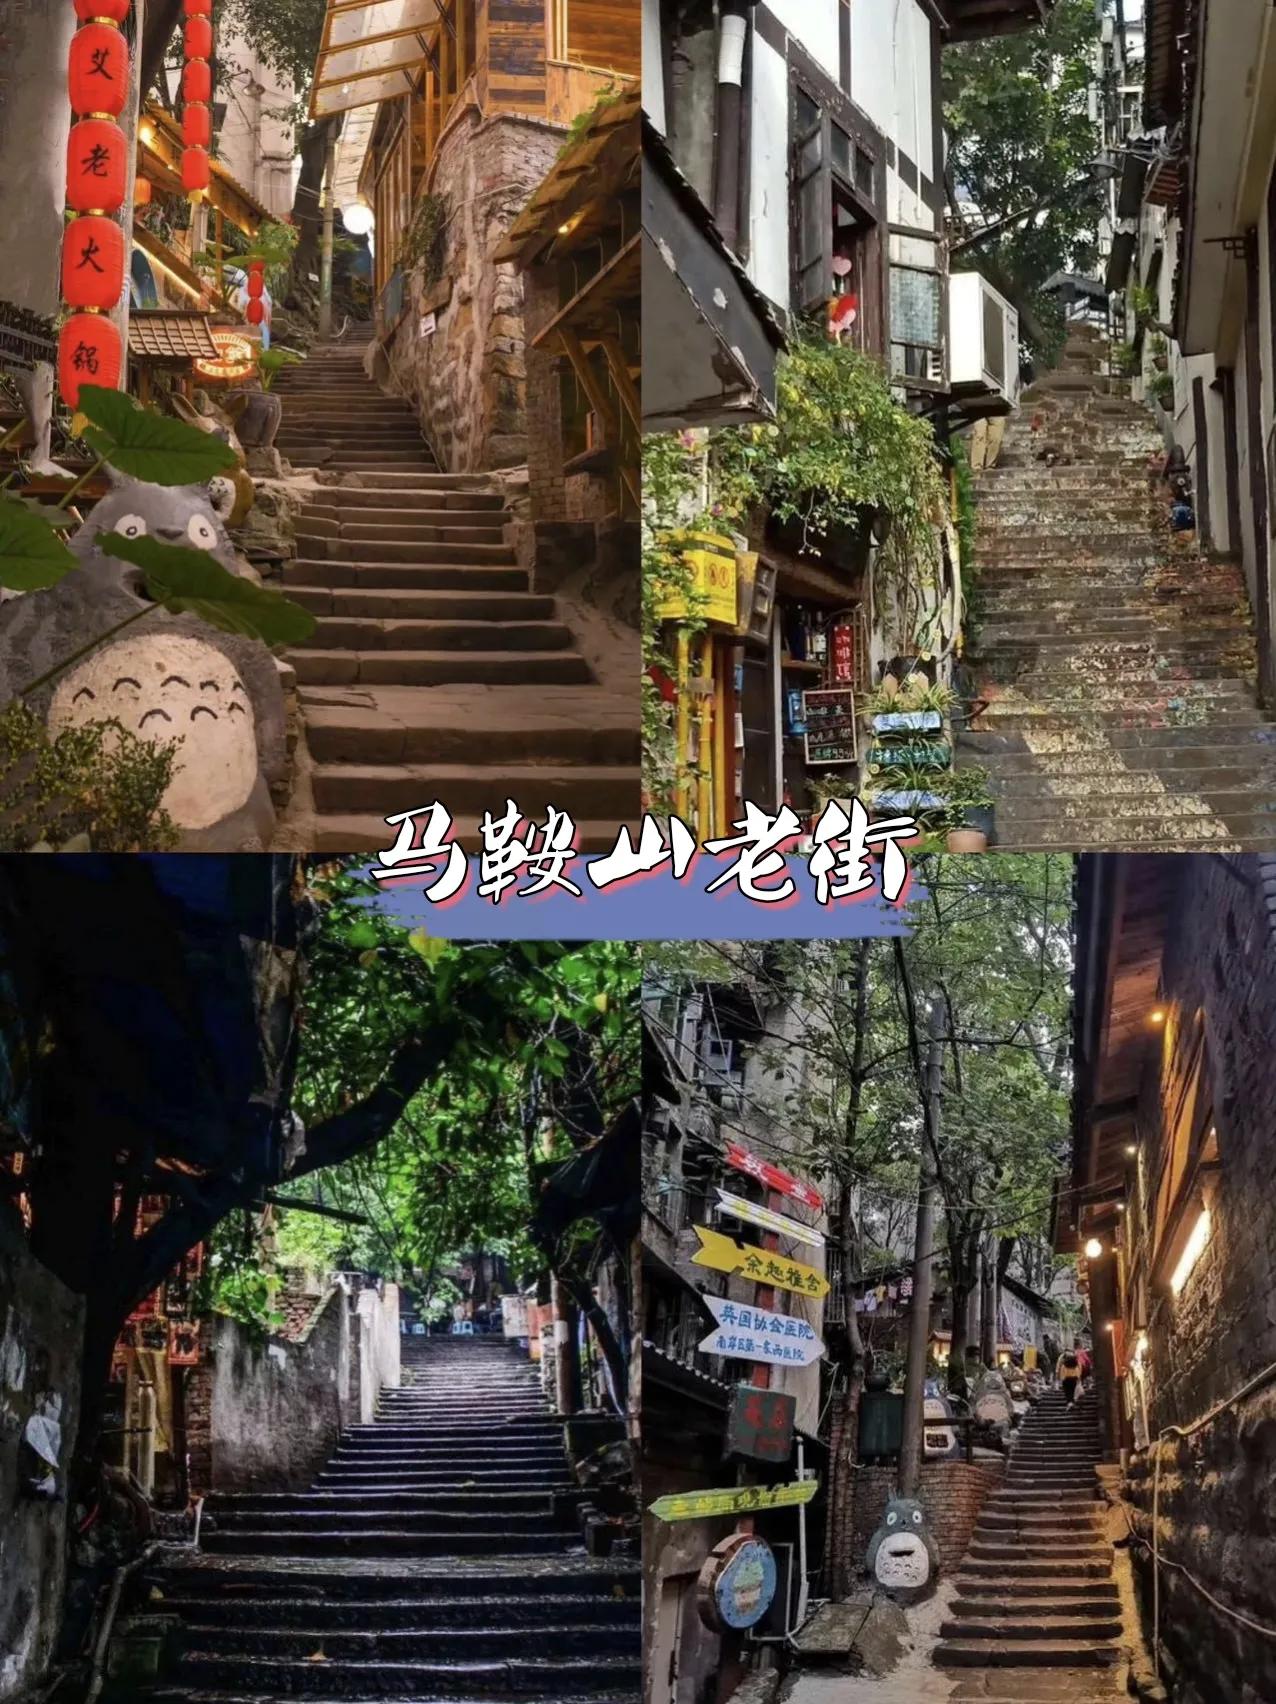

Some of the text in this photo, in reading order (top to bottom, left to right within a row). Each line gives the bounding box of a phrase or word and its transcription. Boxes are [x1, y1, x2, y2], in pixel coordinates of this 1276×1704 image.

[744, 1252, 821, 1292] 余趣雅舍
[719, 1303, 815, 1341] 英国协会医院
